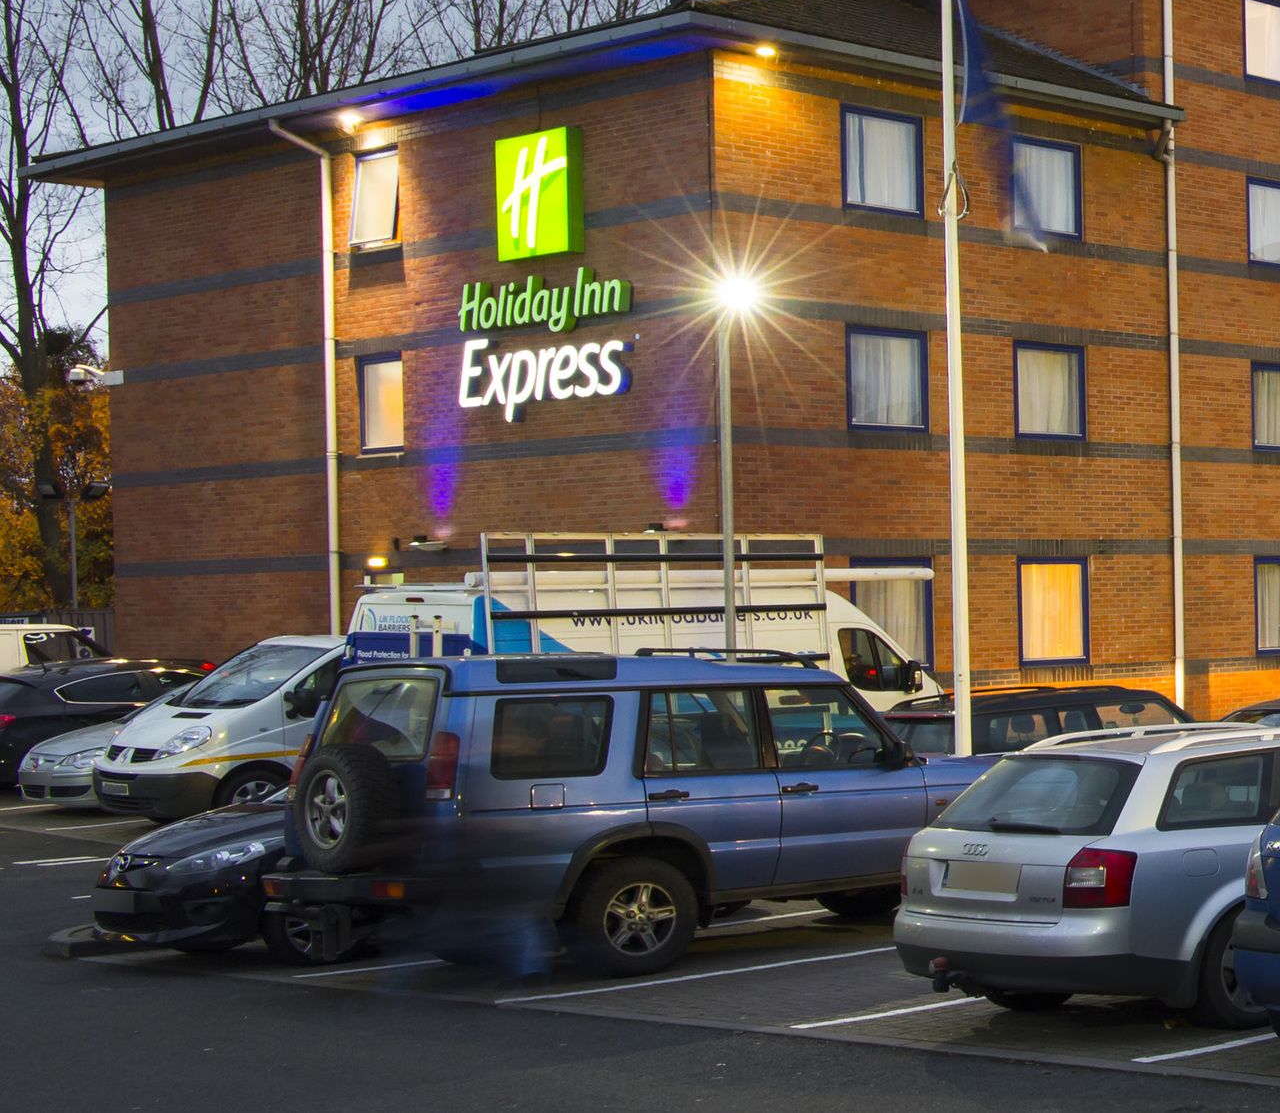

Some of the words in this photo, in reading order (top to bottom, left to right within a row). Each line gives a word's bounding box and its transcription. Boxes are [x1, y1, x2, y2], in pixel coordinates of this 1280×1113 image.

[458, 275, 570, 333] Holiday
[573, 266, 623, 318] Inn
[458, 338, 625, 423] Express
[378, 623, 411, 633] BARRIERS
[356, 649, 372, 658] Flood
[373, 651, 401, 660] Protection
